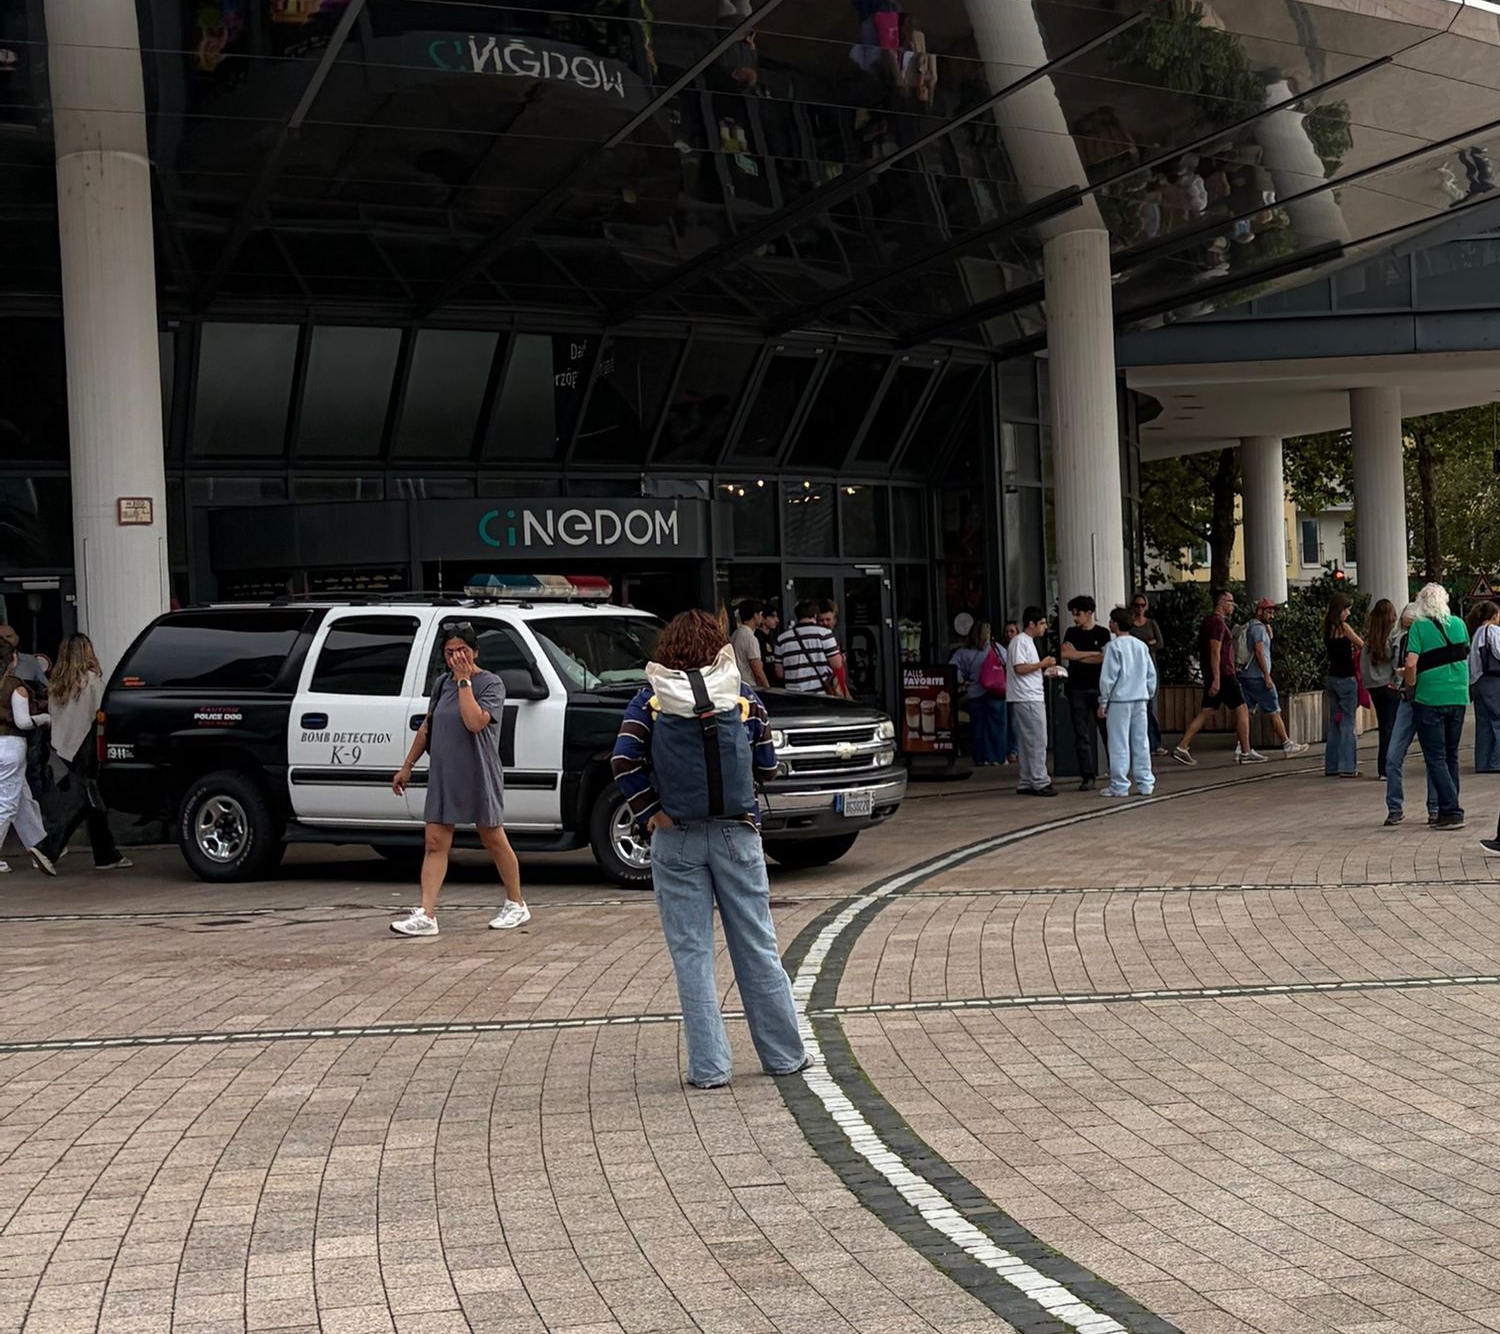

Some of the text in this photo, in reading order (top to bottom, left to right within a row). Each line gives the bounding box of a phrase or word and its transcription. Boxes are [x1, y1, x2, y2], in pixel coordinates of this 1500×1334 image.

[301, 732, 392, 744] BOMB DETECTION
[331, 745, 362, 765] K-9
